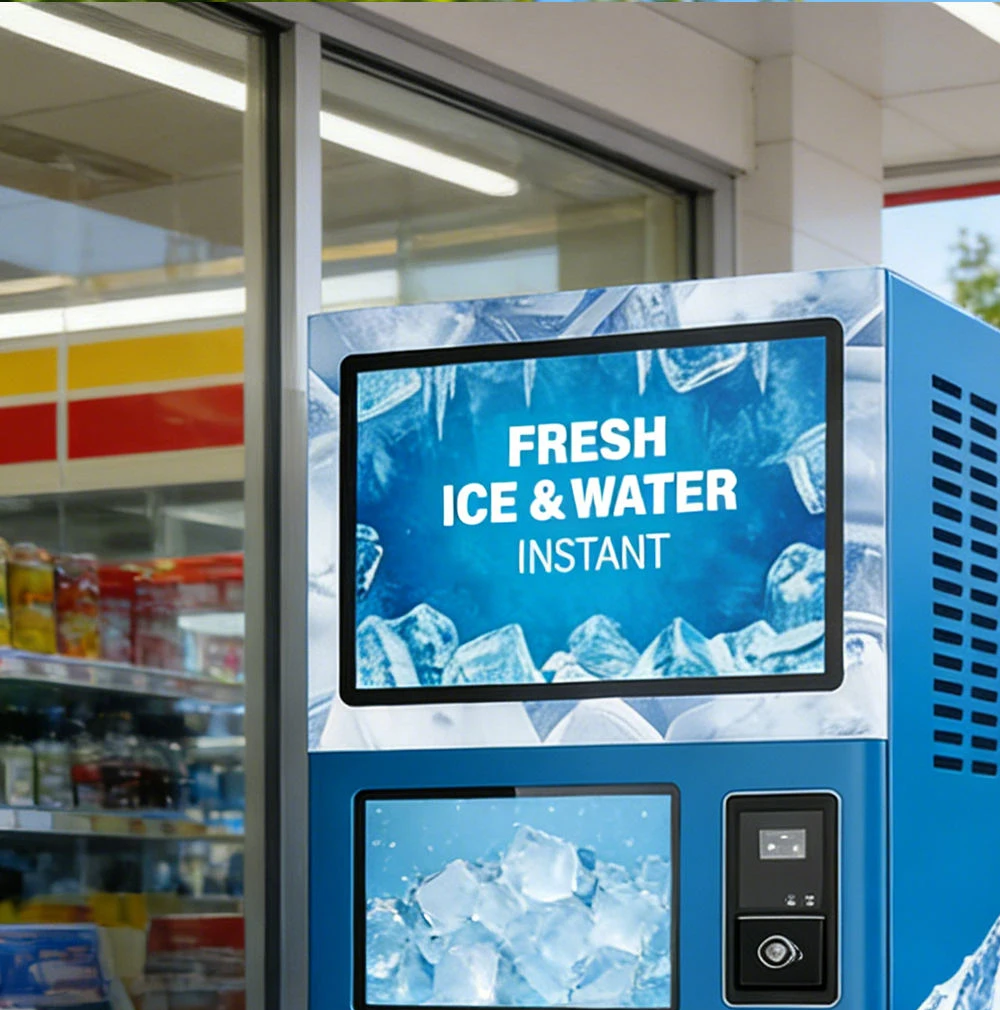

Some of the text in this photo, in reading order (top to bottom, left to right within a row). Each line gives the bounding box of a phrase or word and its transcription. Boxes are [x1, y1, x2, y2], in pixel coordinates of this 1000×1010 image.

[508, 415, 667, 467] FRESH
[442, 468, 738, 526] ICE & WATER
[518, 532, 671, 574] INSTANT
